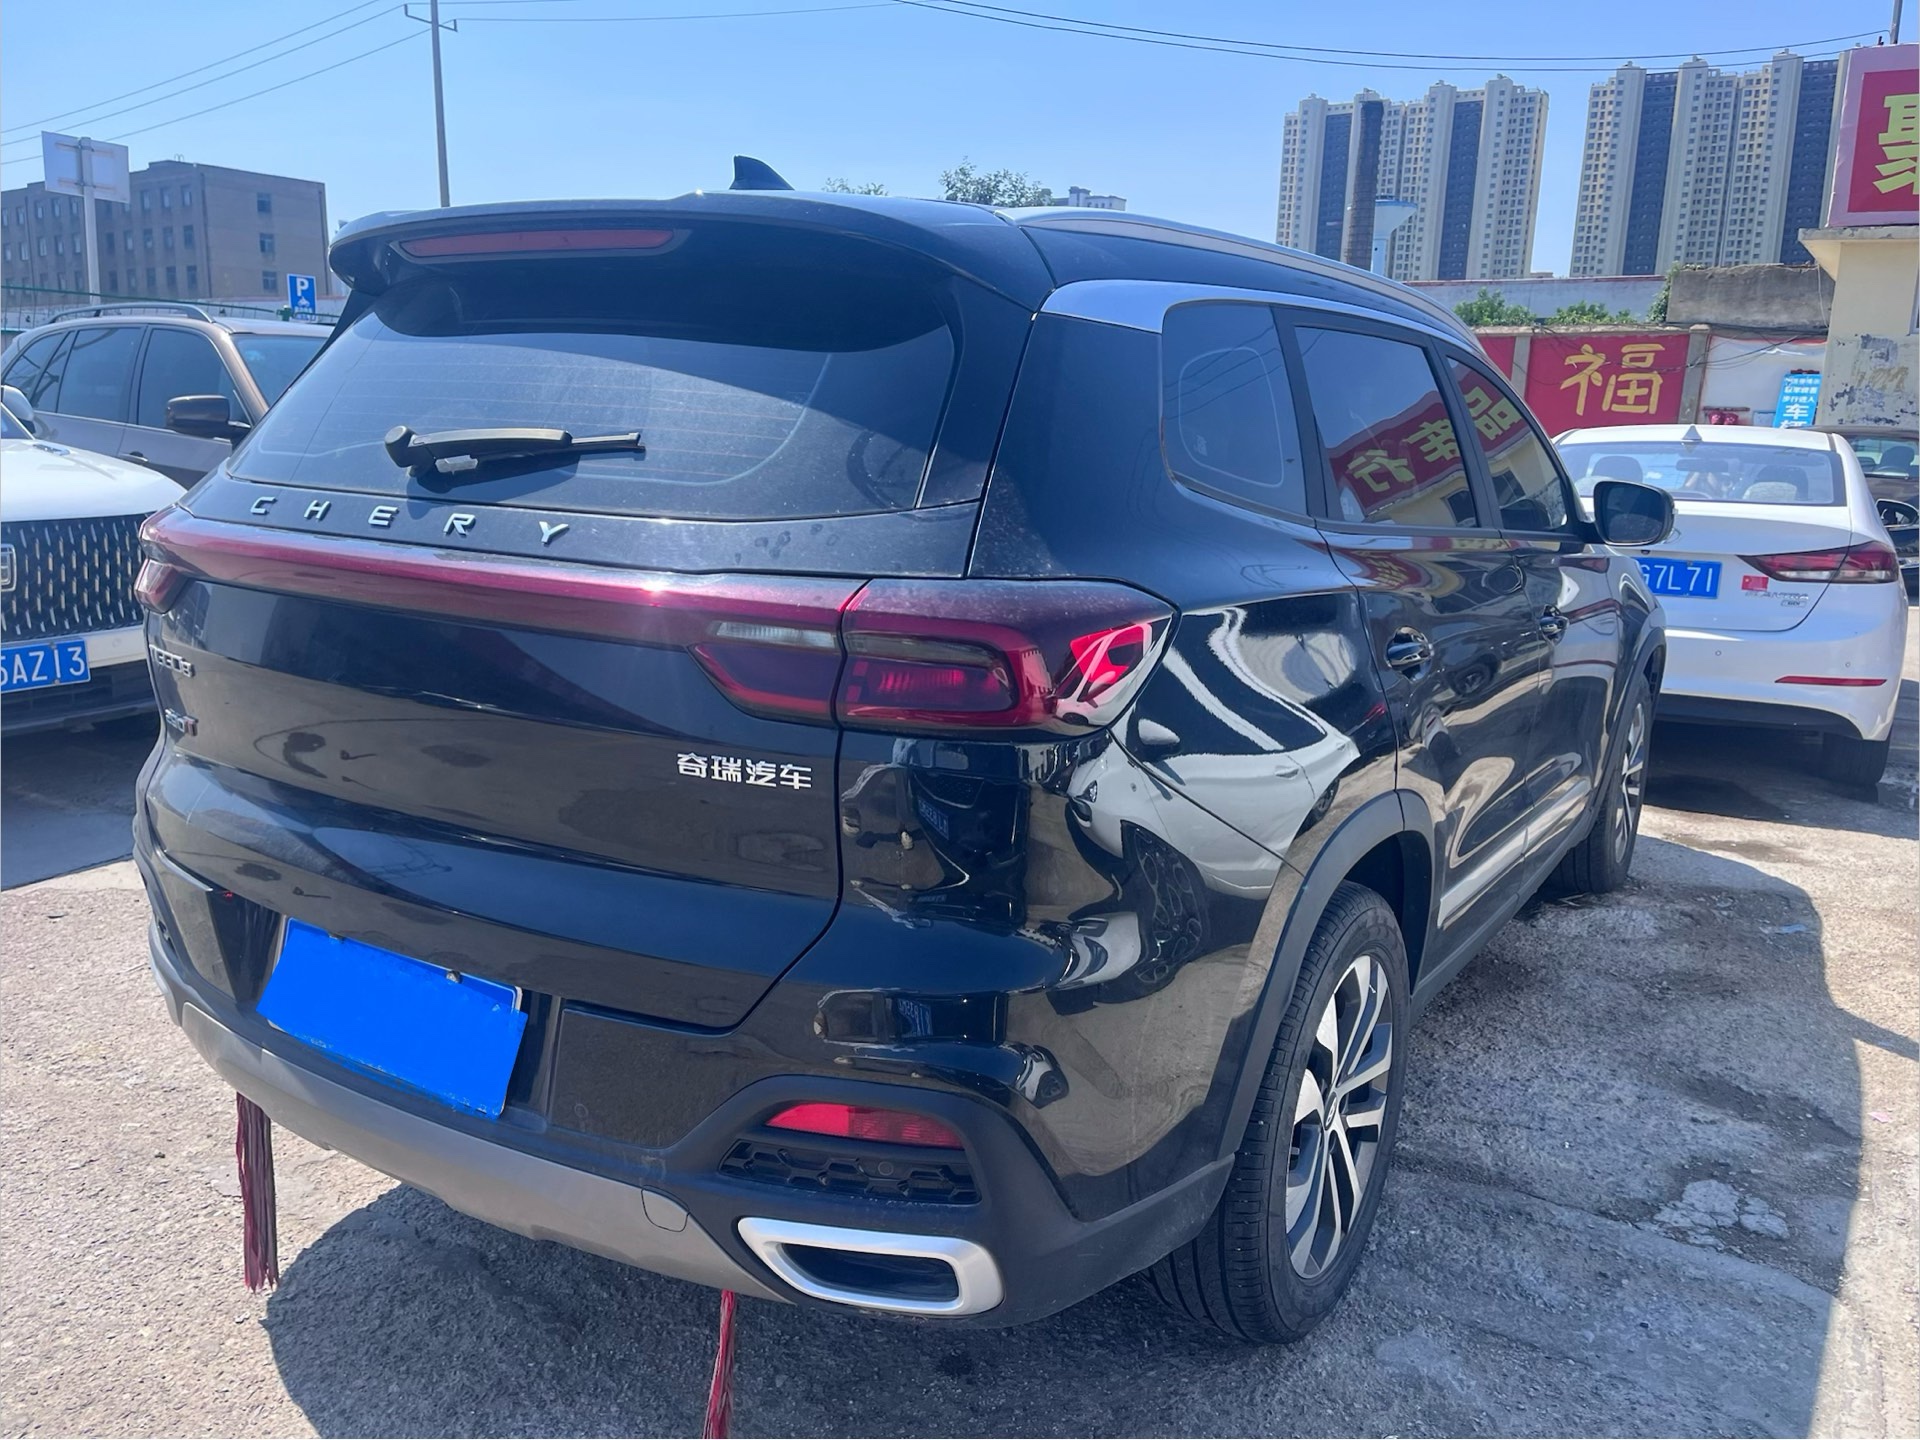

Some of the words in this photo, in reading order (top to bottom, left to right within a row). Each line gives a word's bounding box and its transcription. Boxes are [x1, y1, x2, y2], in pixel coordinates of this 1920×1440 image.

[296, 277, 309, 297] P
[1560, 343, 1666, 416] 福
[250, 496, 570, 545] CHERY
[677, 752, 812, 790] 奇瑞汽车
